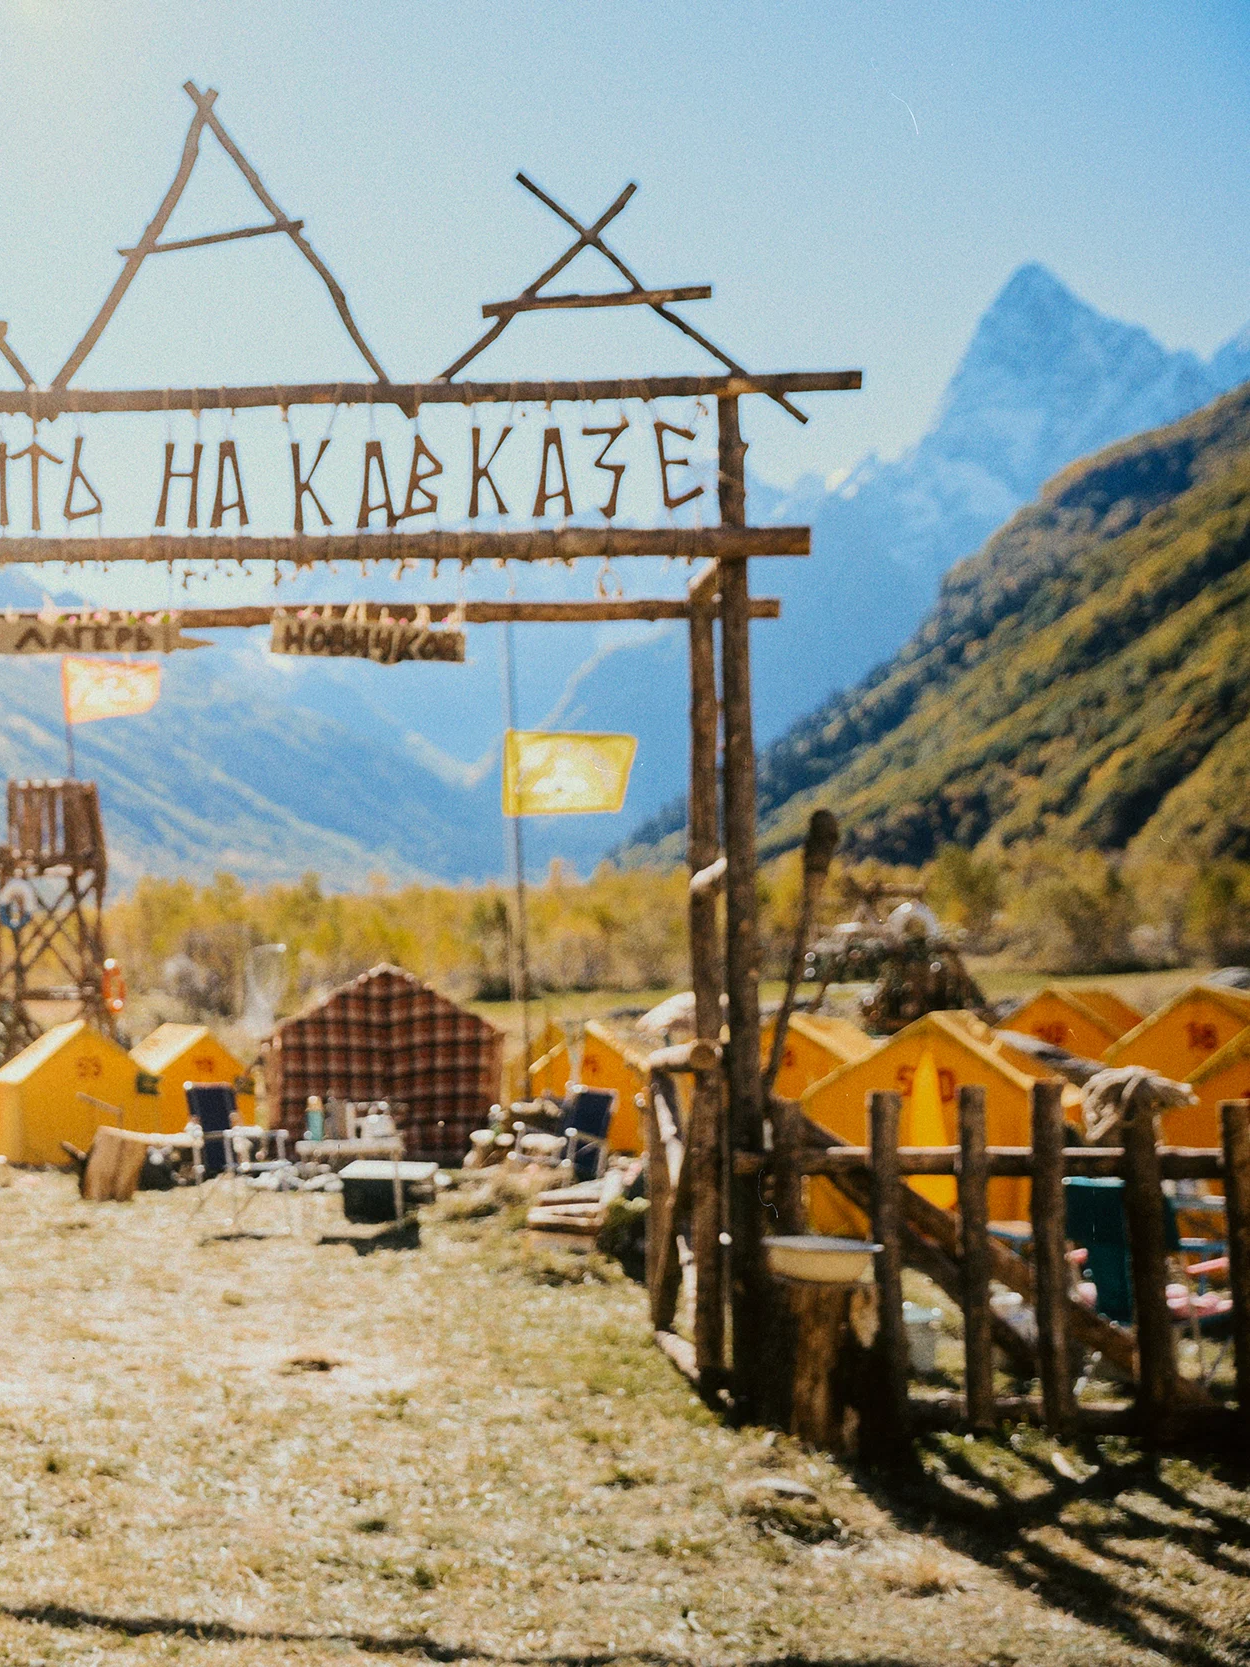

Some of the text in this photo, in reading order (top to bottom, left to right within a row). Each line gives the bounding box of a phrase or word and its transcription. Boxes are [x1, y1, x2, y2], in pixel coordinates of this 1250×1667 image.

[155, 441, 249, 529] НА
[291, 420, 704, 532] КАВКАЗЕ
[15, 626, 152, 651] ЛАГЕРЬ
